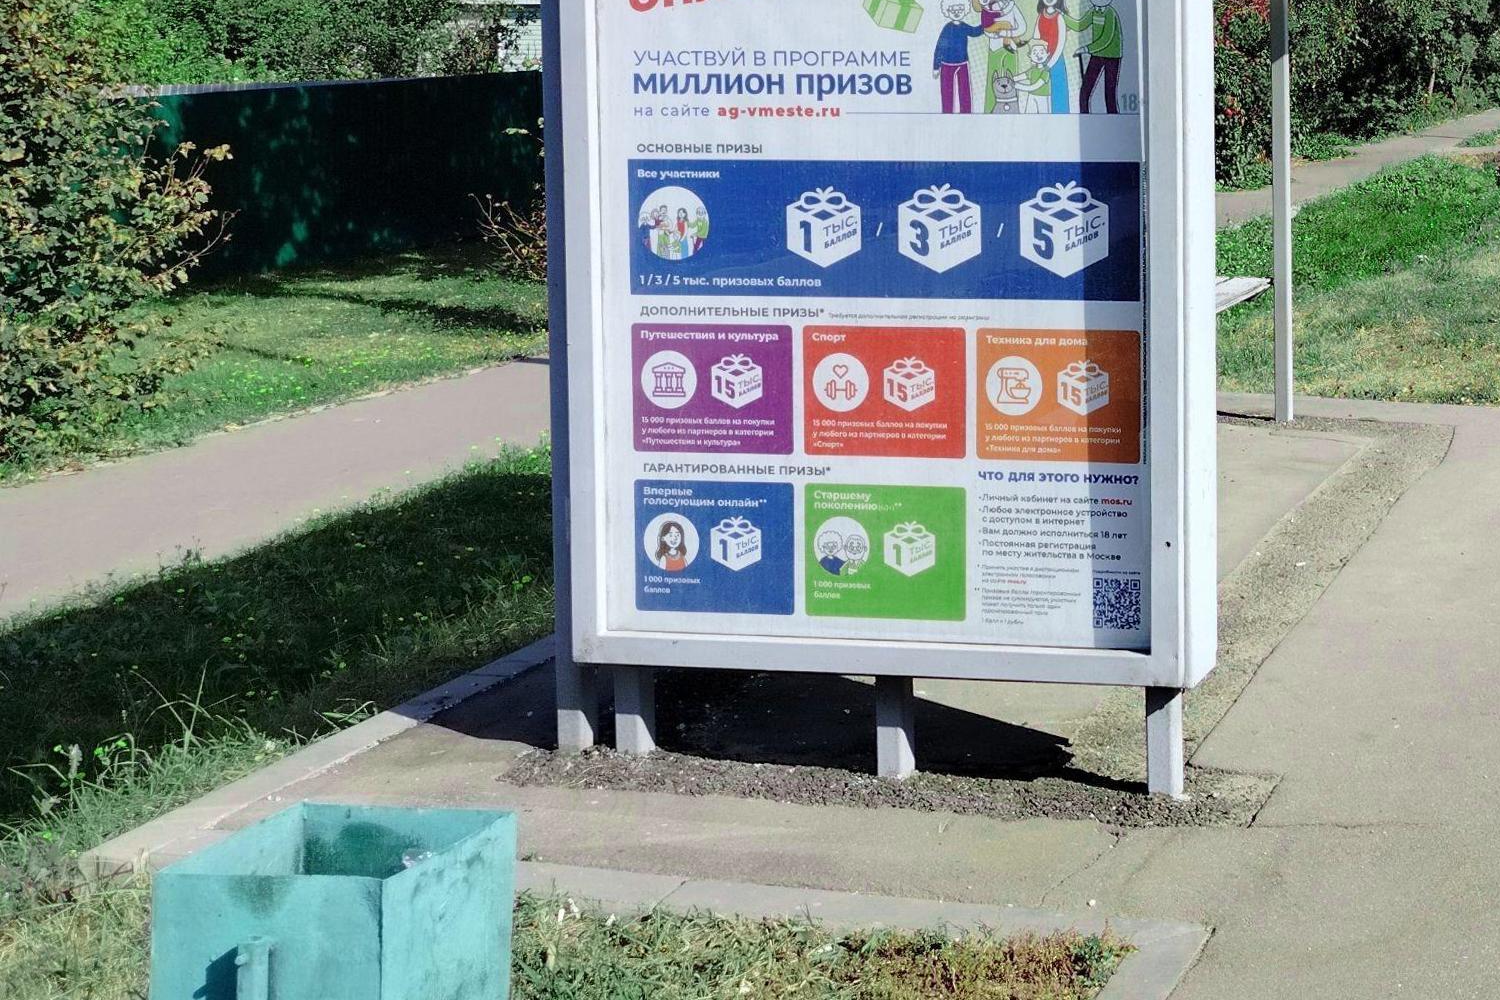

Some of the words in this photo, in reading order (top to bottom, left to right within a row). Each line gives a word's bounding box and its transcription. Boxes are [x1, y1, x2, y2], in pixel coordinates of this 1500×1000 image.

[634, 47, 744, 66] УЧАСТВУЙ
[754, 52, 766, 66] В
[774, 51, 910, 66] ПРОГРАММЕ
[796, 74, 912, 100] призов
[634, 108, 653, 116] на
[661, 104, 710, 116] сайте
[718, 106, 840, 119] ag-vmeste.ru
[636, 144, 712, 153] ОСНОВНЫЕ
[717, 144, 762, 154] ПРИЗЫ
[637, 169, 657, 178] Все
[660, 170, 720, 180] участники
[800, 220, 812, 253] 1
[909, 219, 929, 256] 3
[1033, 218, 1054, 260] 5
[713, 278, 773, 288] призовых
[778, 276, 821, 287] баллов
[640, 306, 768, 318] ДОПОЛНИТЕЛЬНЫЕ
[641, 330, 715, 341] Путешествия
[728, 333, 778, 342] культура
[812, 333, 846, 342] Спорт
[986, 335, 1032, 345] Техника
[1035, 337, 1056, 346] для
[1059, 338, 1088, 346] дома
[715, 375, 735, 399] 15
[887, 378, 907, 402] 15
[1060, 382, 1081, 406] 15
[643, 463, 775, 475] ГАРАНТИРОВАННЫЕ
[978, 471, 1003, 481] ЧТО
[1008, 472, 1034, 482] ДЛЯ
[1039, 472, 1079, 482] ЭТОГО
[1084, 475, 1138, 484] НУЖНО?
[643, 487, 692, 497] Впервые
[814, 490, 871, 502] Старшему
[643, 498, 715, 507] голосующим
[1076, 509, 1127, 518] устройство
[989, 517, 1032, 525] доступом
[720, 539, 728, 561] 1
[893, 543, 902, 566] 1
